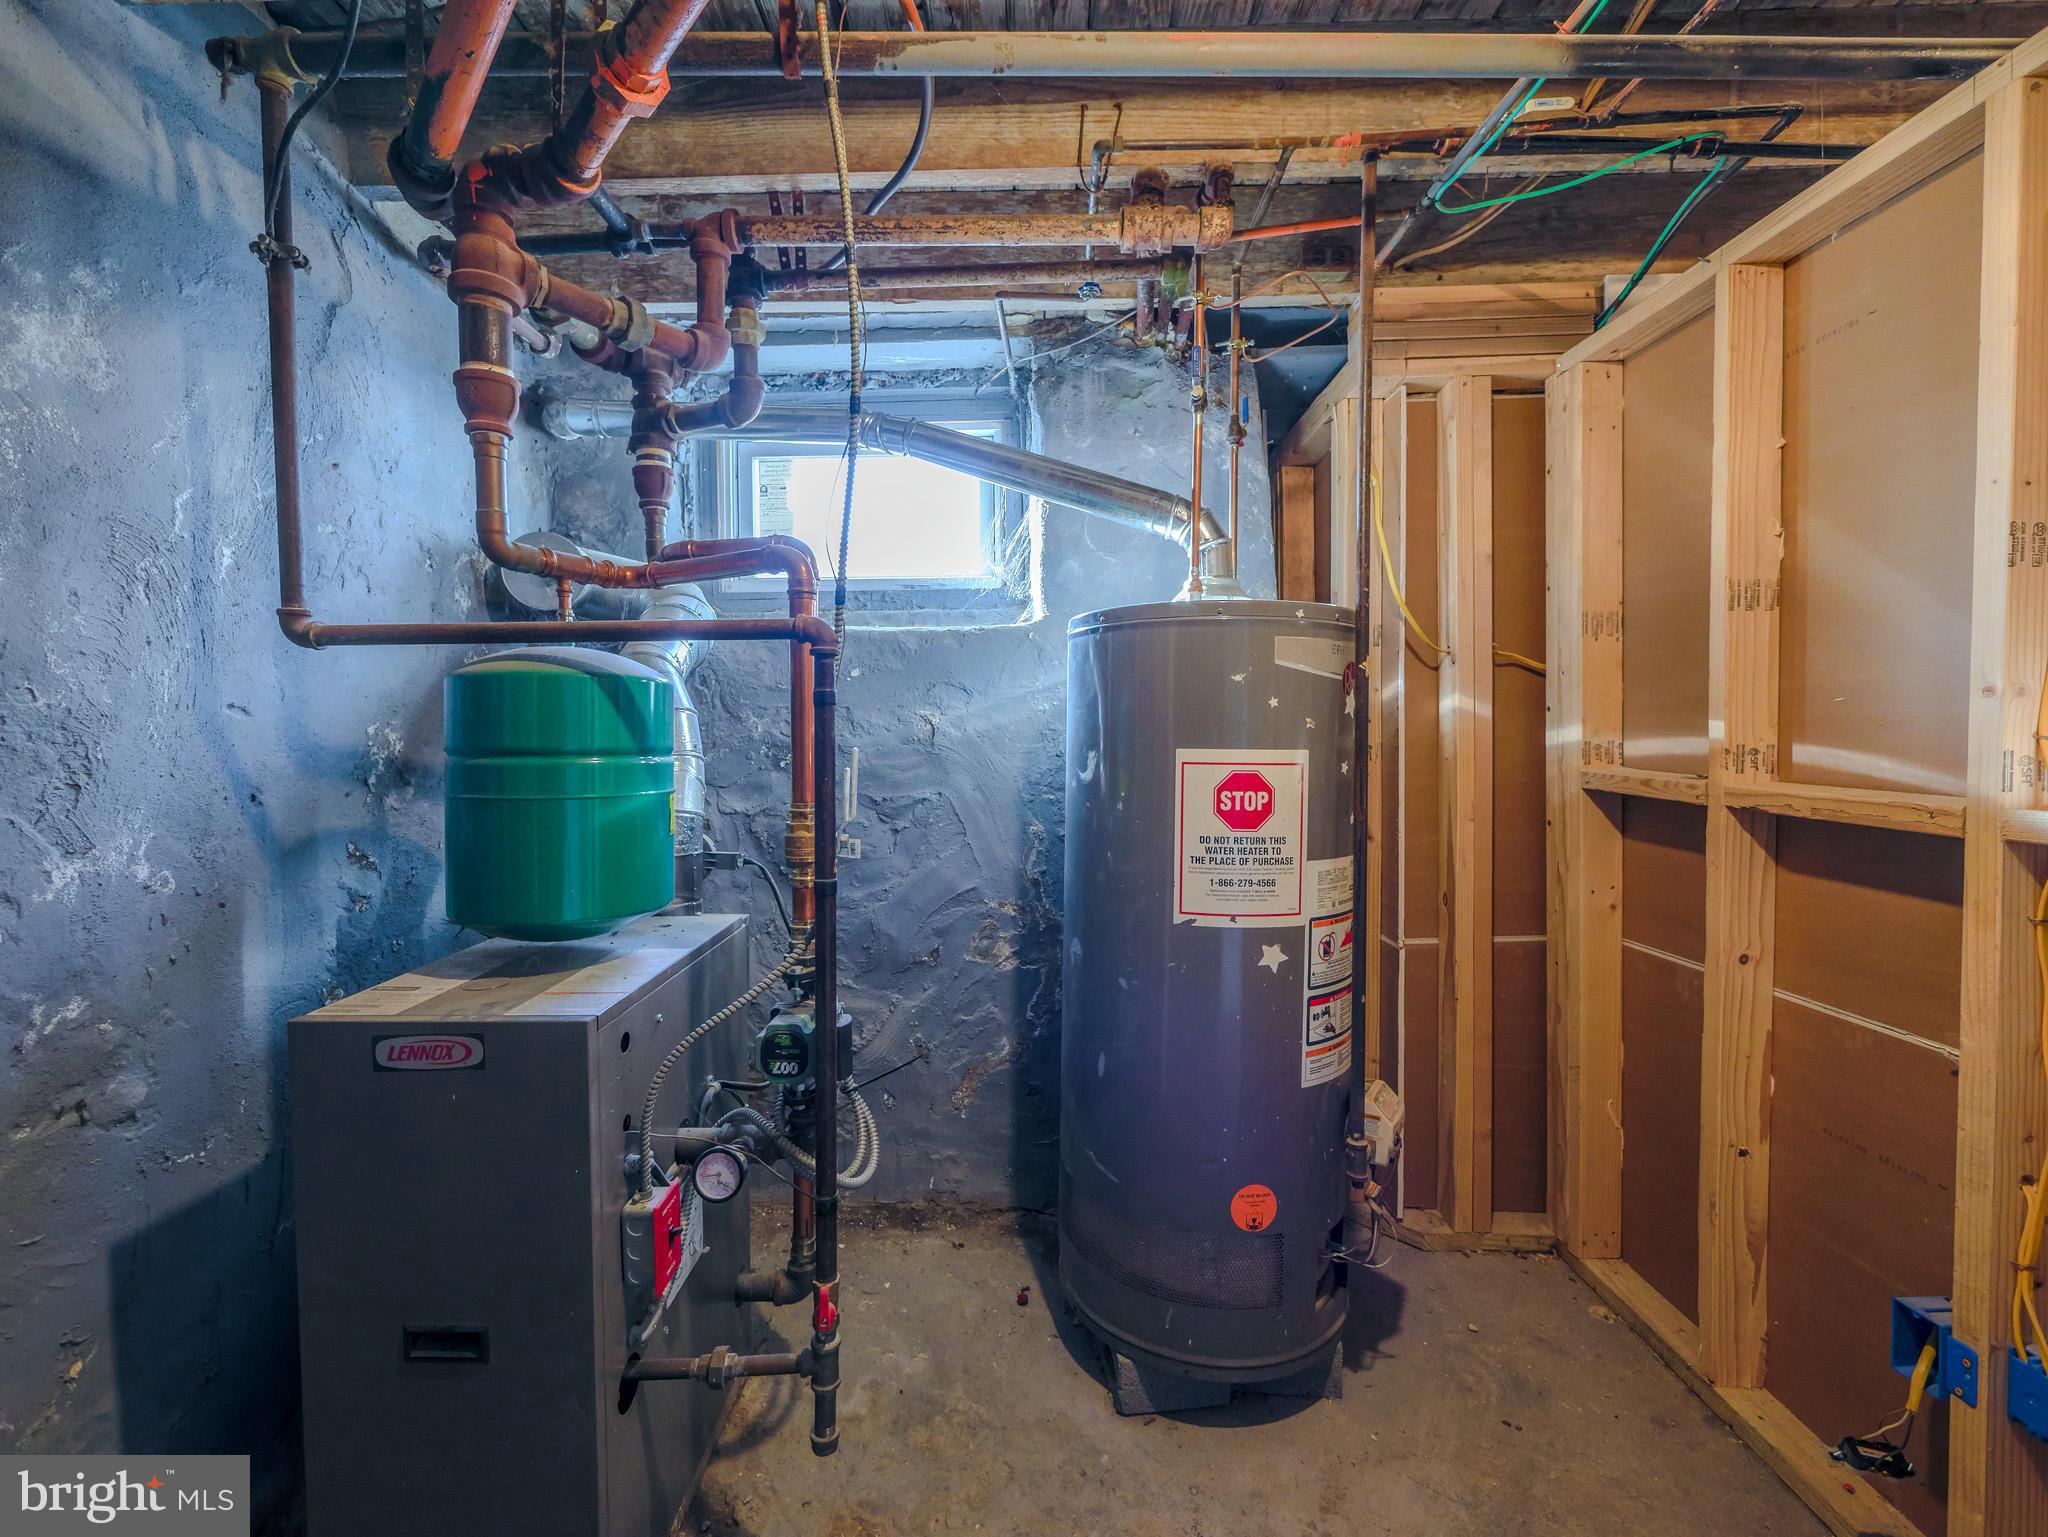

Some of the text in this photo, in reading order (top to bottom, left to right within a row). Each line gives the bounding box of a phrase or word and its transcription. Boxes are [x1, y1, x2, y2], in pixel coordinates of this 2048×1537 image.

[1220, 790, 1269, 811] STOP
[1199, 836, 1287, 845] DO NOT RETURN THIS
[1205, 847, 1281, 856] WATER HEATER TO
[1190, 856, 1294, 865] THE PLACE OF PURCHASE
[1209, 878, 1277, 887] 1-866-279-4566
[387, 1044, 456, 1062] LENNOX
